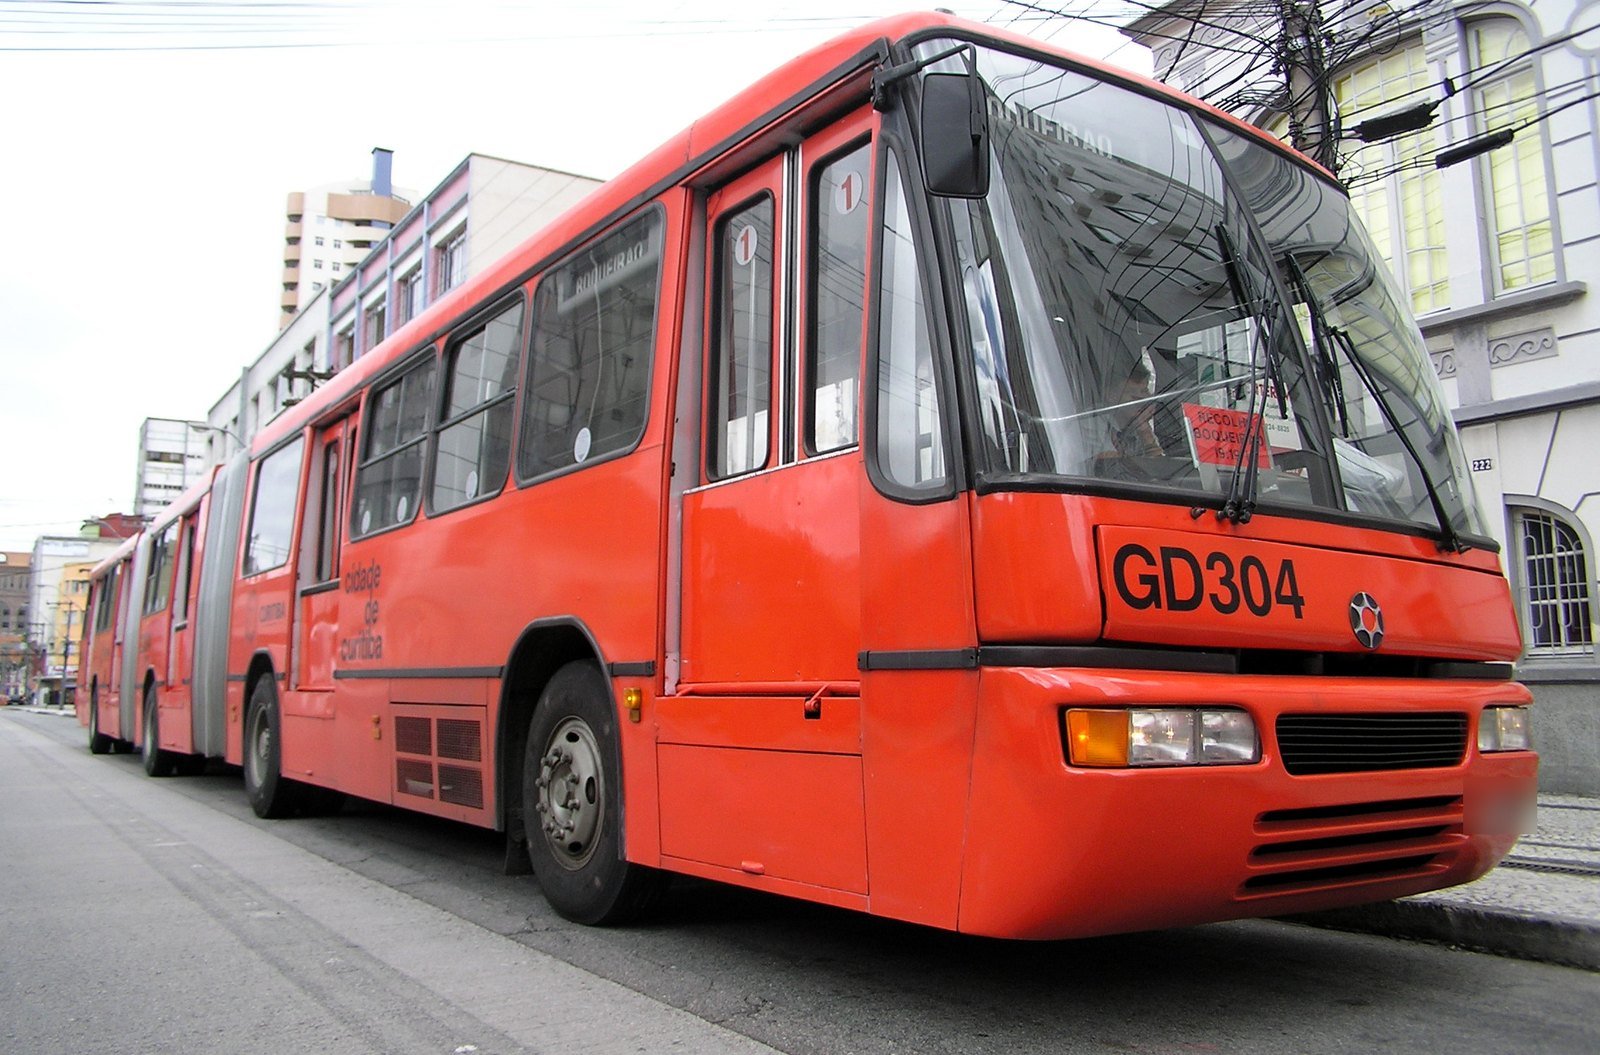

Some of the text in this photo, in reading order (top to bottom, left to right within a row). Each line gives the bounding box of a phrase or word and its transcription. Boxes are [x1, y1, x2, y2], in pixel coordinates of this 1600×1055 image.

[841, 173, 852, 211] 1
[740, 228, 749, 262] 1
[1473, 459, 1491, 471] 222
[345, 559, 381, 594] cidade
[1113, 543, 1305, 619] GD304
[364, 590, 379, 625] de
[341, 627, 382, 661] curitiba
